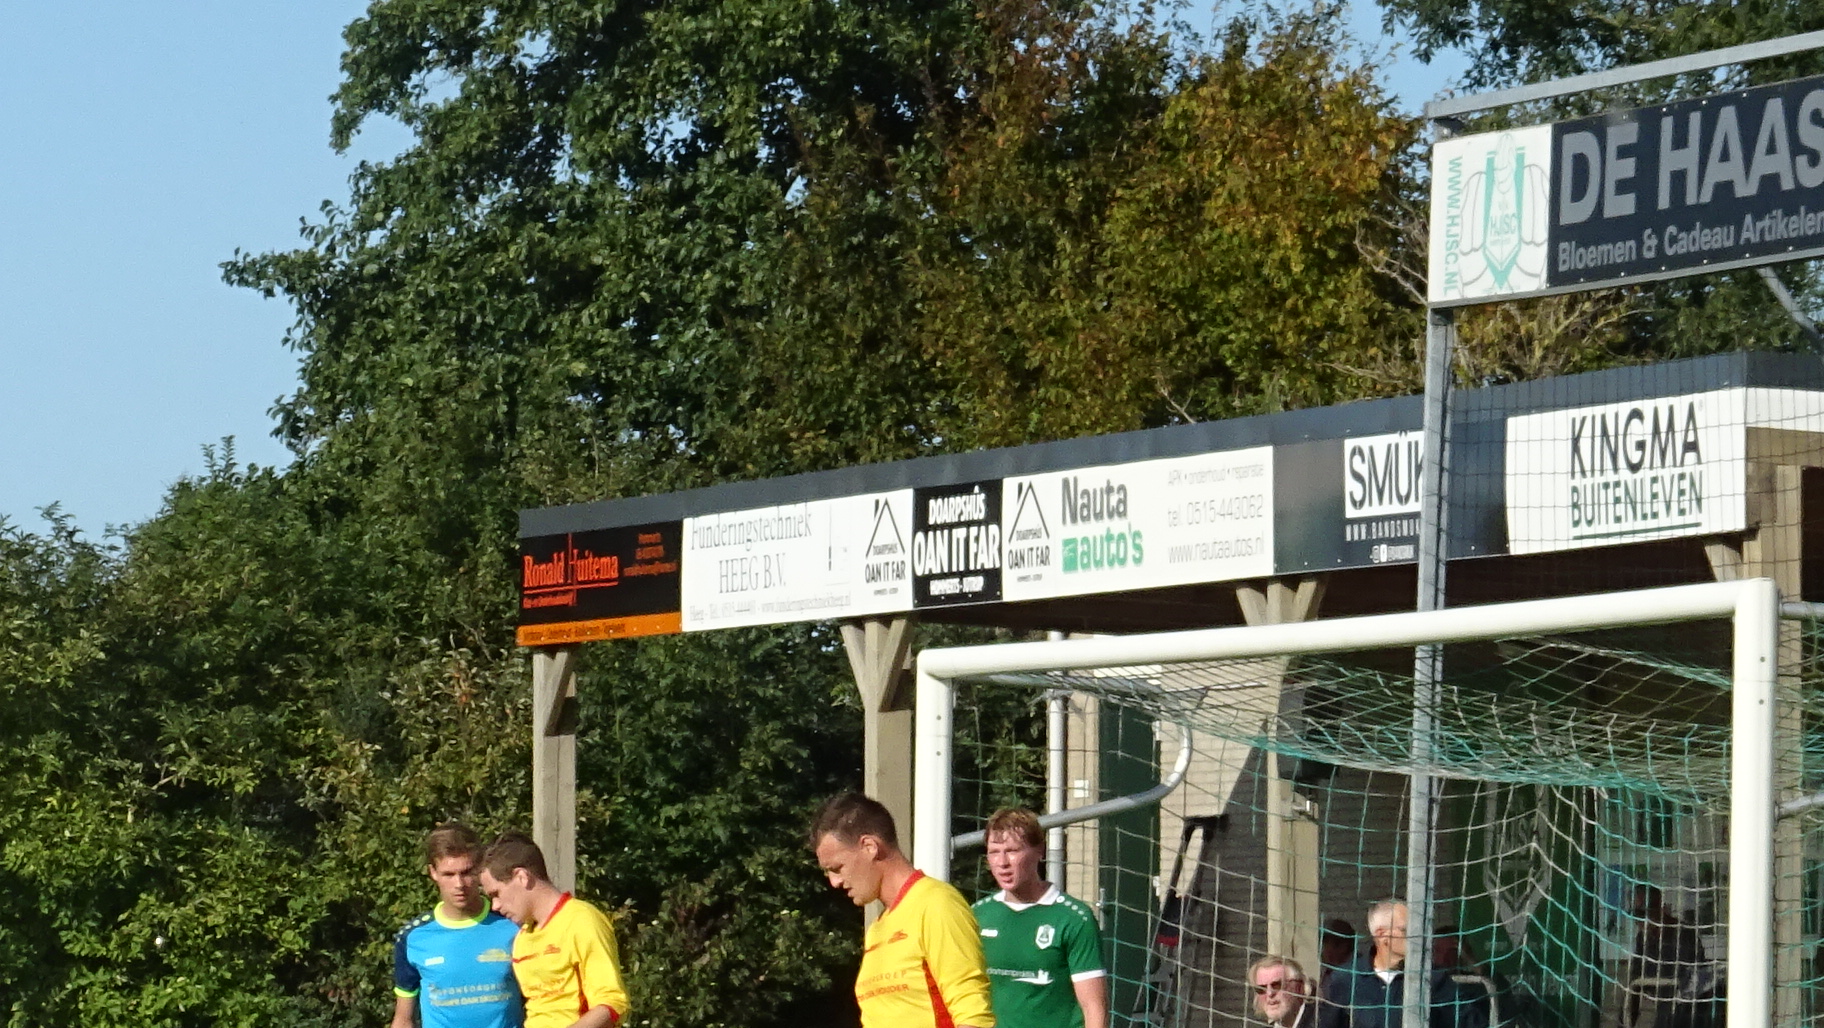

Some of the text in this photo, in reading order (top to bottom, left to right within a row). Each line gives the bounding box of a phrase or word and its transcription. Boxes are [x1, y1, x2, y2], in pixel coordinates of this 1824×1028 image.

[1560, 89, 1824, 226] DE HAAS
[1443, 156, 1462, 297] WWW.HJSC.NL
[1558, 240, 1637, 272] Bloemen
[1642, 227, 1658, 259] &
[1664, 222, 1734, 256] Cadeau
[1570, 401, 1702, 480] KINGMA
[929, 485, 986, 525] DOARPSHÛS
[1061, 476, 1128, 526] Nauta
[1571, 470, 1703, 528] BUITENLEVEN
[690, 502, 812, 552] Funderingstechniek
[914, 524, 1000, 576] OAN IT FAR
[1080, 521, 1144, 571] auto's
[522, 552, 565, 588] Ronald
[718, 556, 759, 594] HEEG
[763, 553, 786, 589] B.V.
[865, 560, 906, 584] OAN IT FAR
[1008, 545, 1050, 570] OAN IT FAR
